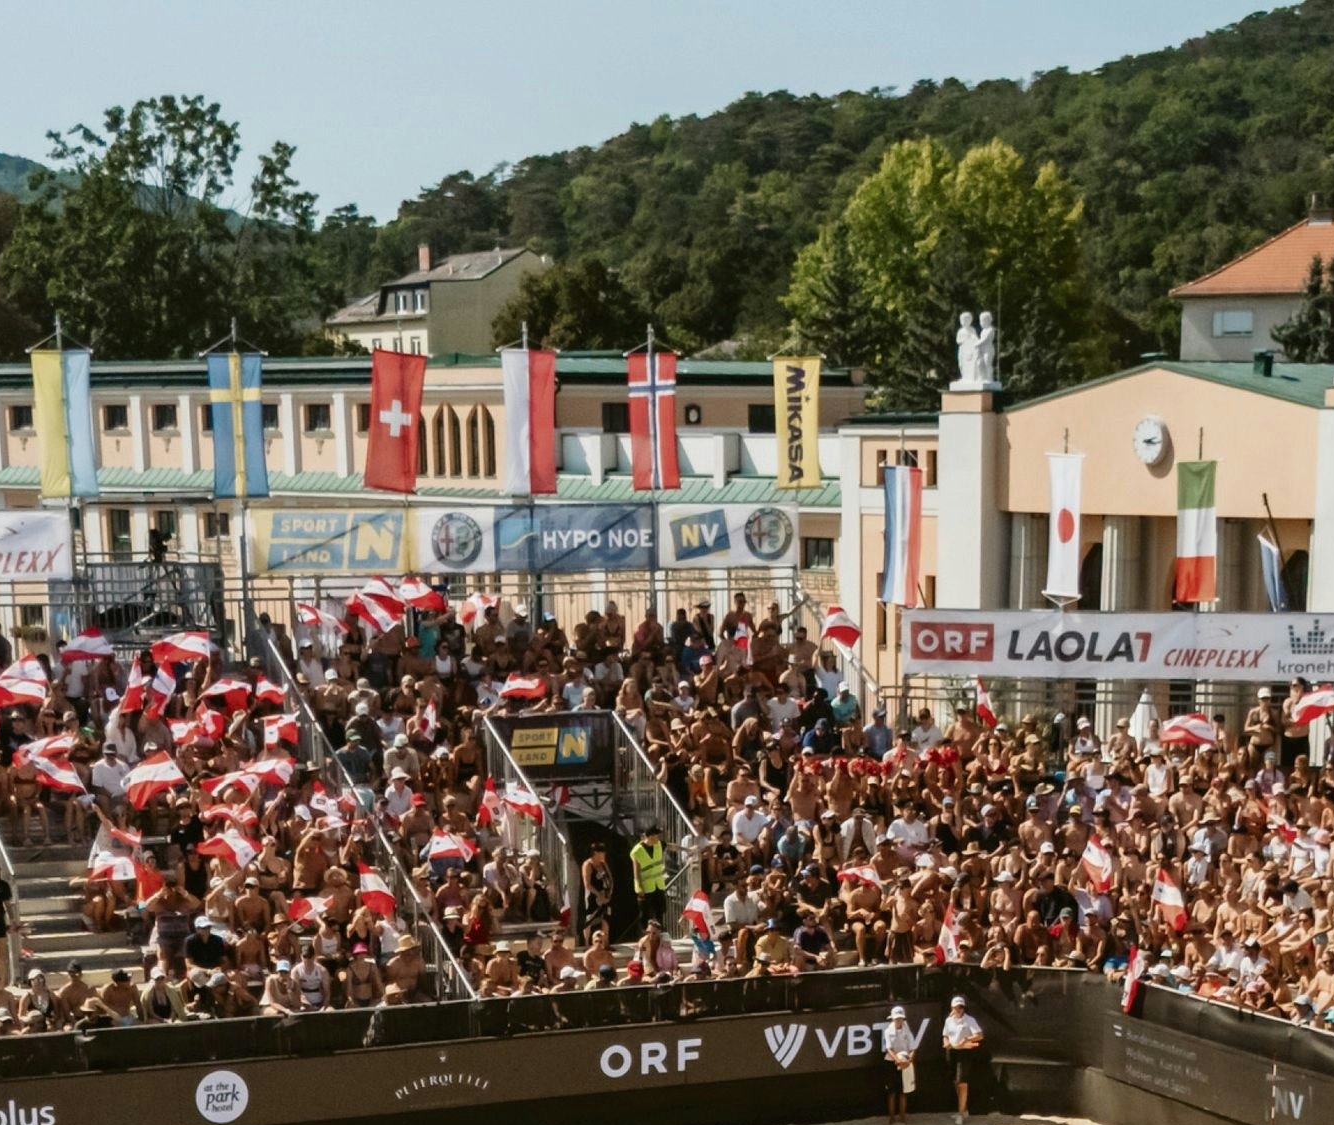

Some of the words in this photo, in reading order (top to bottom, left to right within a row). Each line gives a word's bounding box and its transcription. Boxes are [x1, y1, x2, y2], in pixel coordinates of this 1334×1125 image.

[786, 365, 807, 483] MIKASA
[280, 518, 340, 534] SPORT
[680, 523, 720, 547] NV
[542, 529, 601, 549] HYPO
[608, 528, 654, 548] NOE
[282, 551, 332, 564] LAND
[917, 629, 989, 653] ORF
[1163, 644, 1270, 669] CINEPLEXX
[600, 1039, 703, 1079] ORF
[206, 1083, 240, 1111] park
[216, 1082, 230, 1091] the
